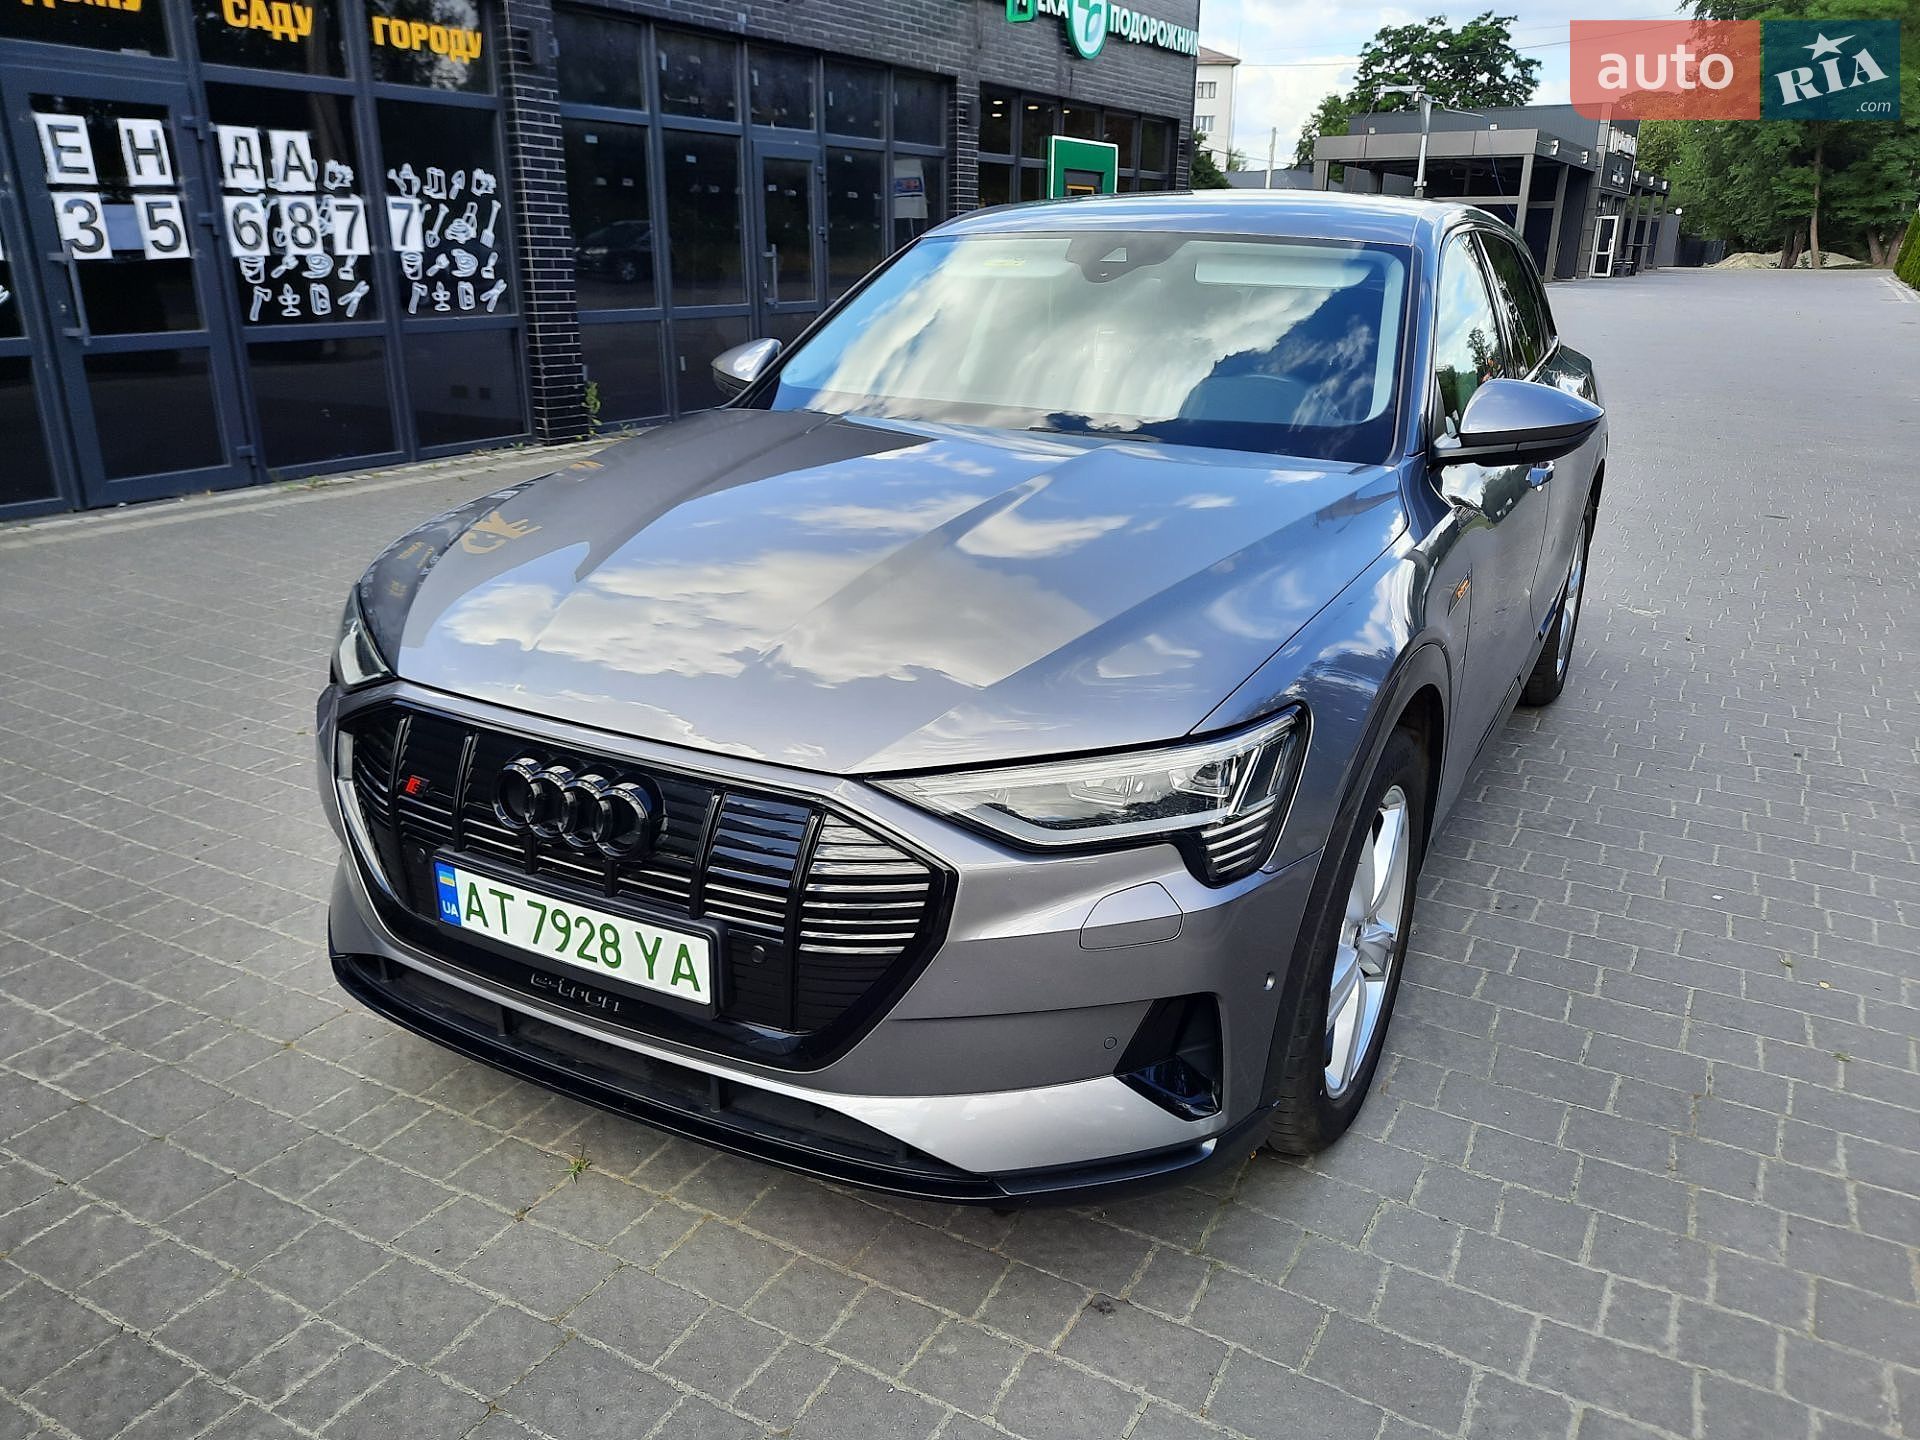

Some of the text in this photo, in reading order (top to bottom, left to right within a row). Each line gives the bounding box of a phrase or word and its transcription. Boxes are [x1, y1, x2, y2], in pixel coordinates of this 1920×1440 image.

[372, 16, 483, 64] ГОРОДУ
[1109, 5, 1200, 57] ПОДОРОЖНИК
[442, 899, 459, 918] UA
[465, 882, 701, 993] AT 7928 YA
